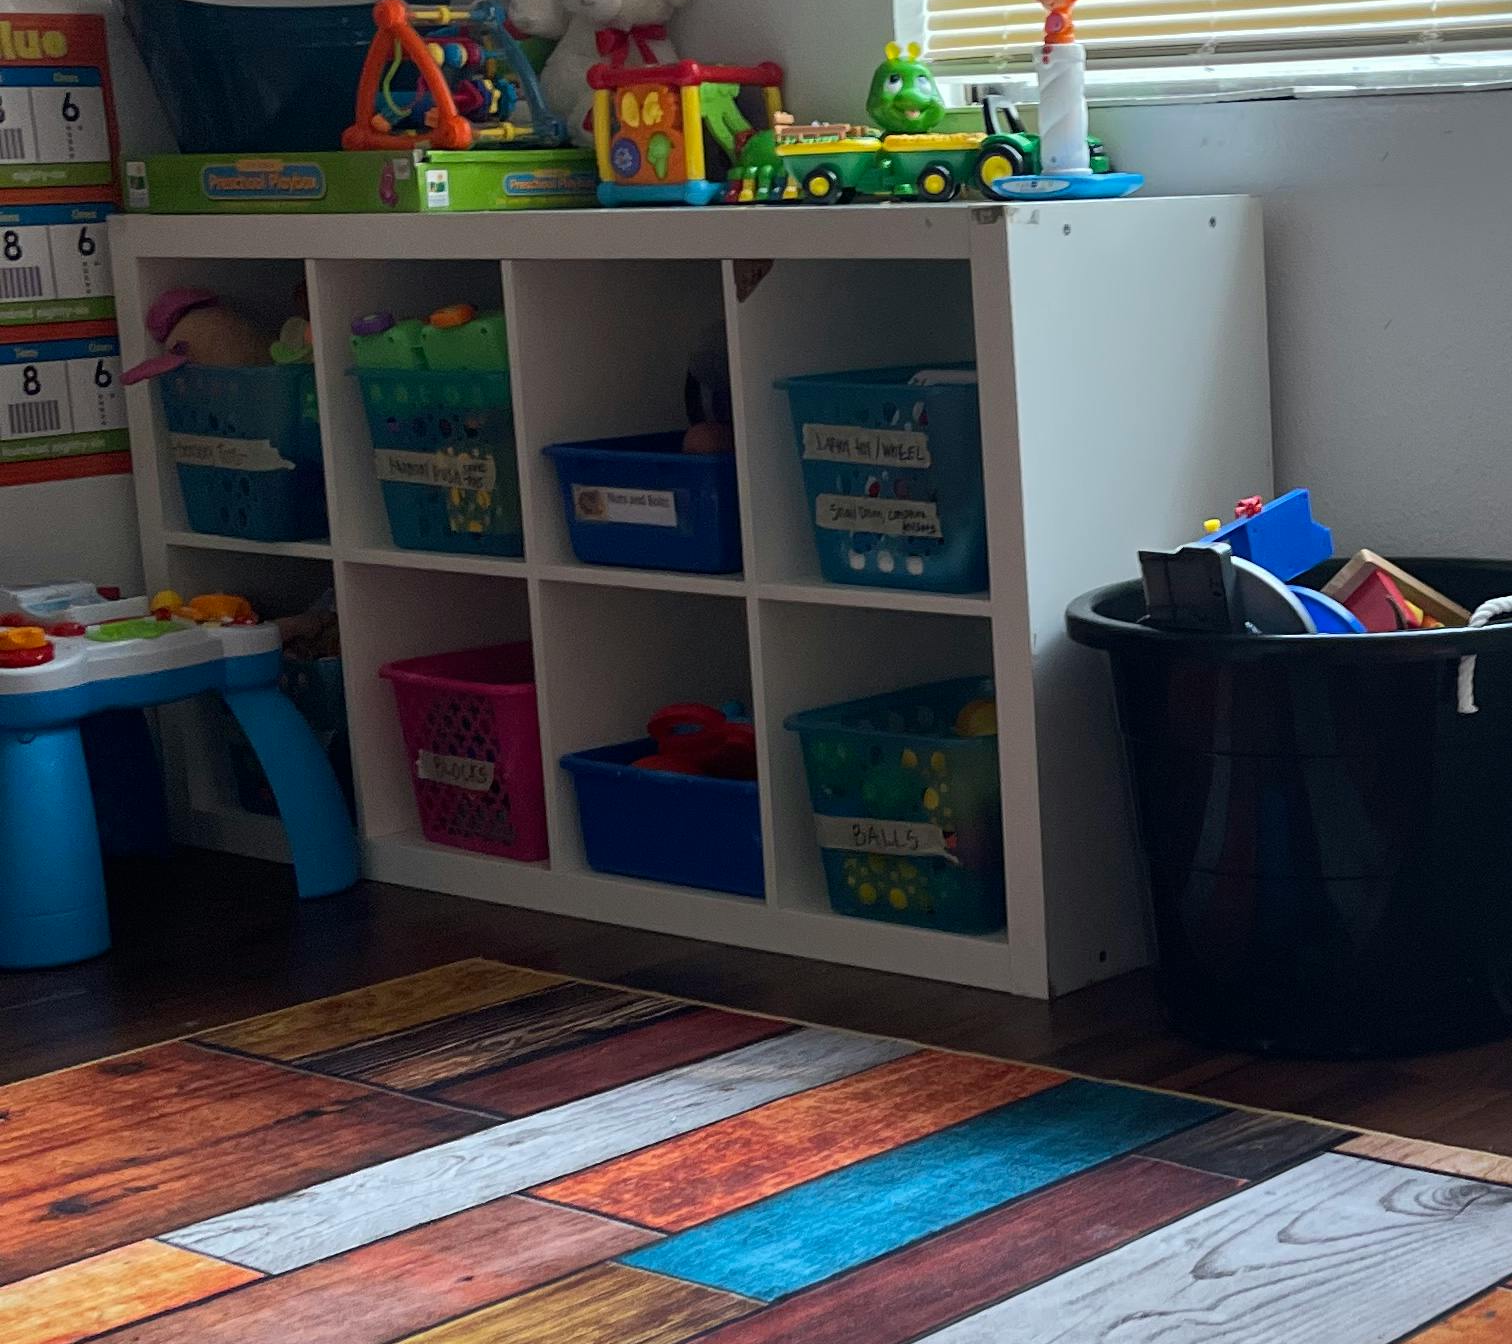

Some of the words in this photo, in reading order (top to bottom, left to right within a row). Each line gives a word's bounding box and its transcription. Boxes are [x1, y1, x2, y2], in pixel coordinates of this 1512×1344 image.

[62, 91, 81, 122] 6
[3, 229, 23, 262] 8
[78, 226, 96, 256] 6
[23, 364, 42, 396] 8
[94, 359, 113, 389] 6
[852, 823, 920, 851] BALLS
